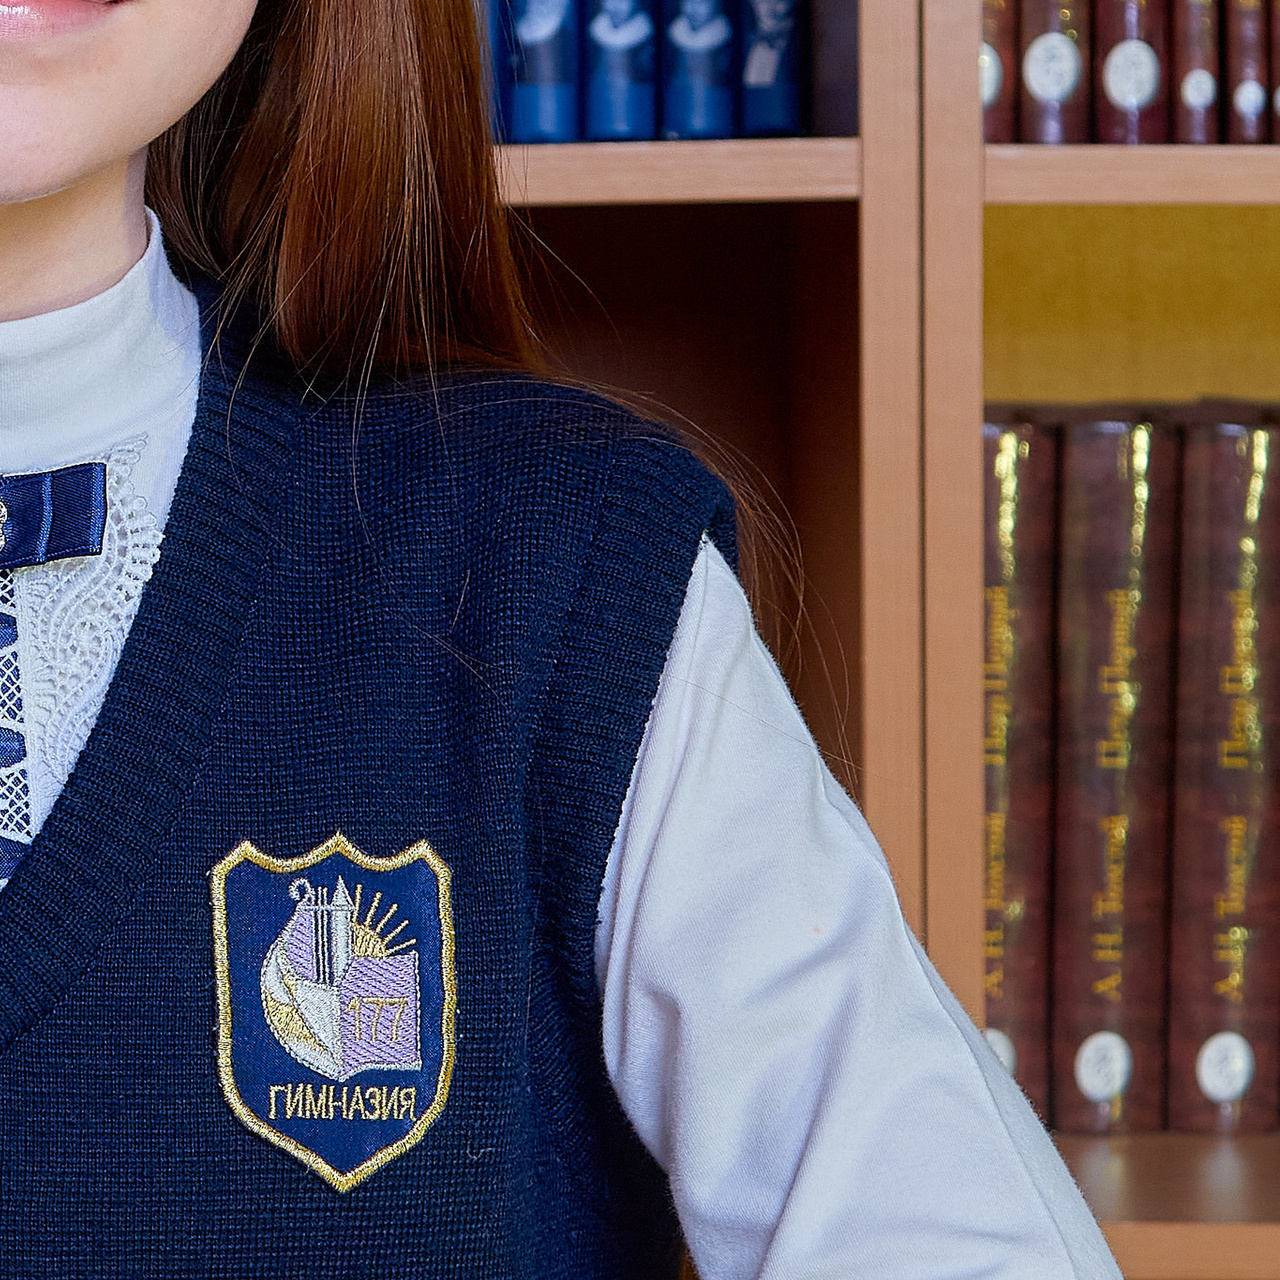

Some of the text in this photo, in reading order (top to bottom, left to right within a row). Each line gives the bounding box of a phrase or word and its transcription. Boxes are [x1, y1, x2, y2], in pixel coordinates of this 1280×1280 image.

[1091, 814, 1127, 920] Толстой
[1213, 814, 1247, 920] Толстой
[346, 996, 408, 1043] 177
[269, 1085, 417, 1121] ГИМНАЗИЯ
